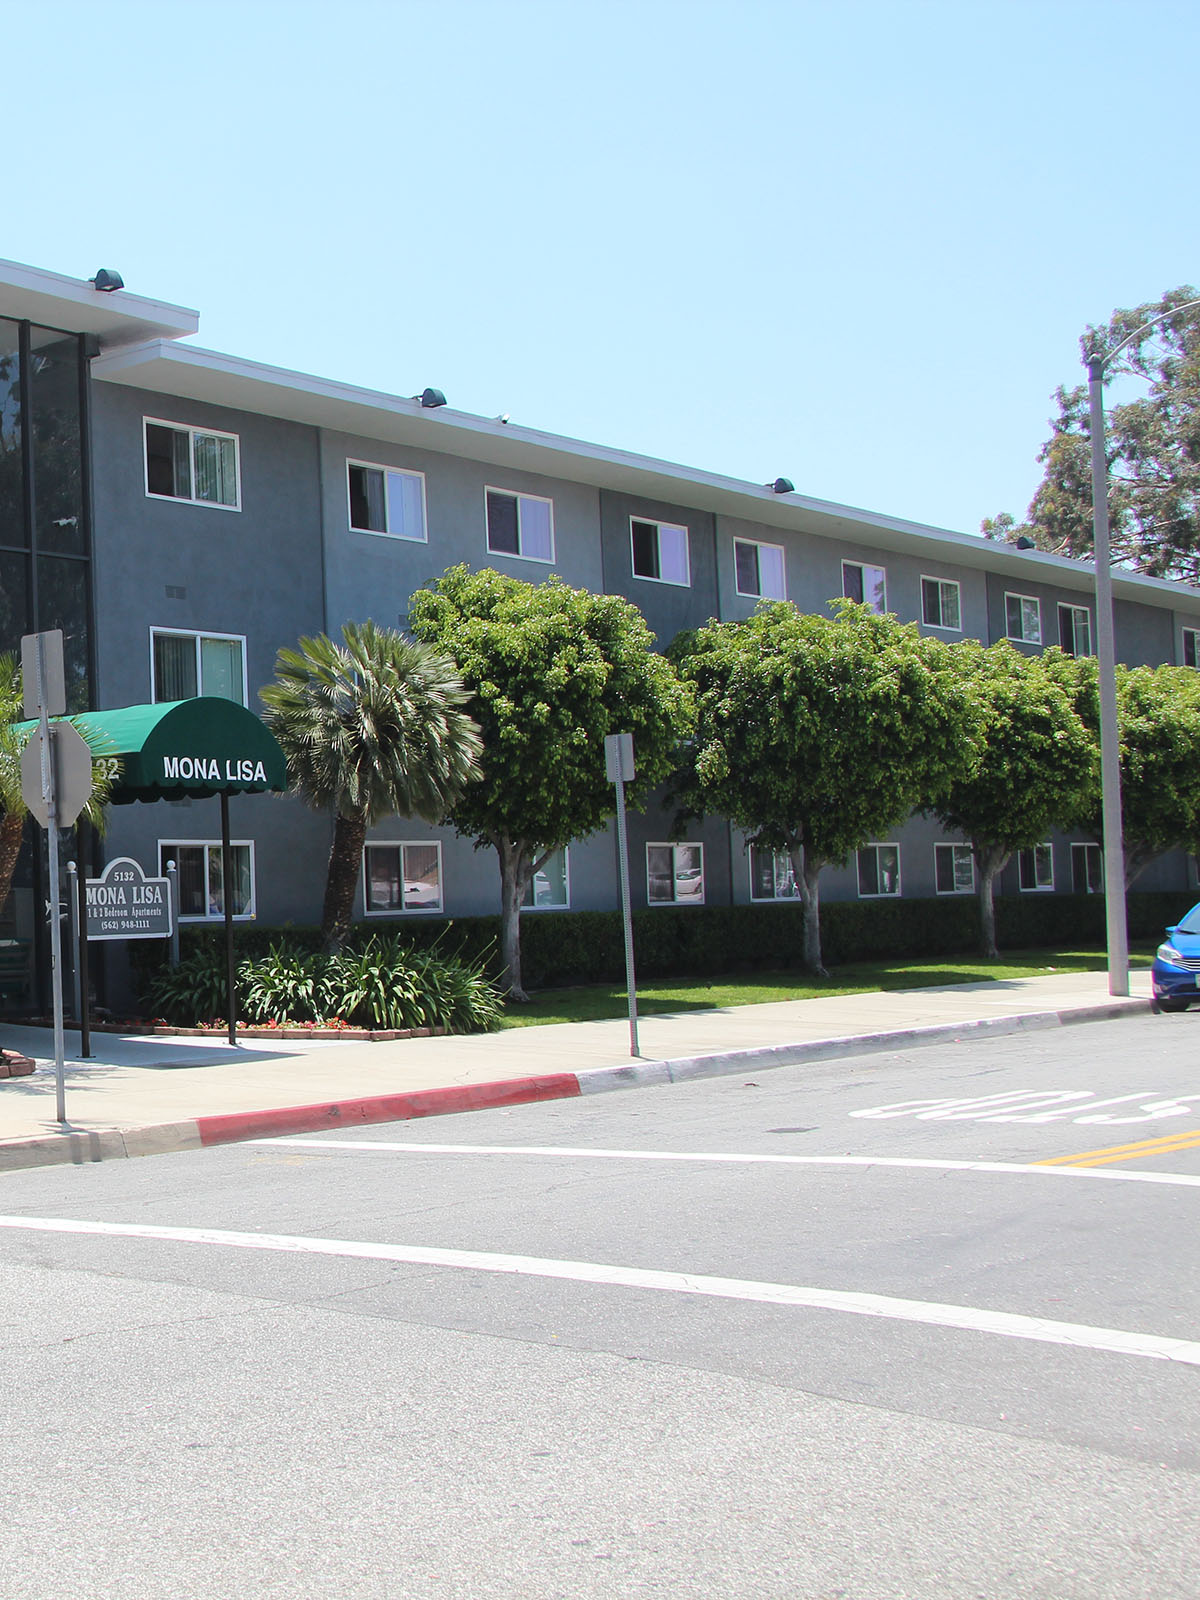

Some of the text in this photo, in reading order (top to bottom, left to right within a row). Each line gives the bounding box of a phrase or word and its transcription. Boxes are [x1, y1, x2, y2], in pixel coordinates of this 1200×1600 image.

[163, 756, 267, 782] MONA LISA
[114, 871, 135, 882] 5132
[86, 885, 163, 906] MONA LISA
[104, 906, 128, 917] Bedroom
[132, 906, 162, 919] Apartments
[101, 920, 118, 931] (562)
[848, 1089, 1200, 1125] STOP
